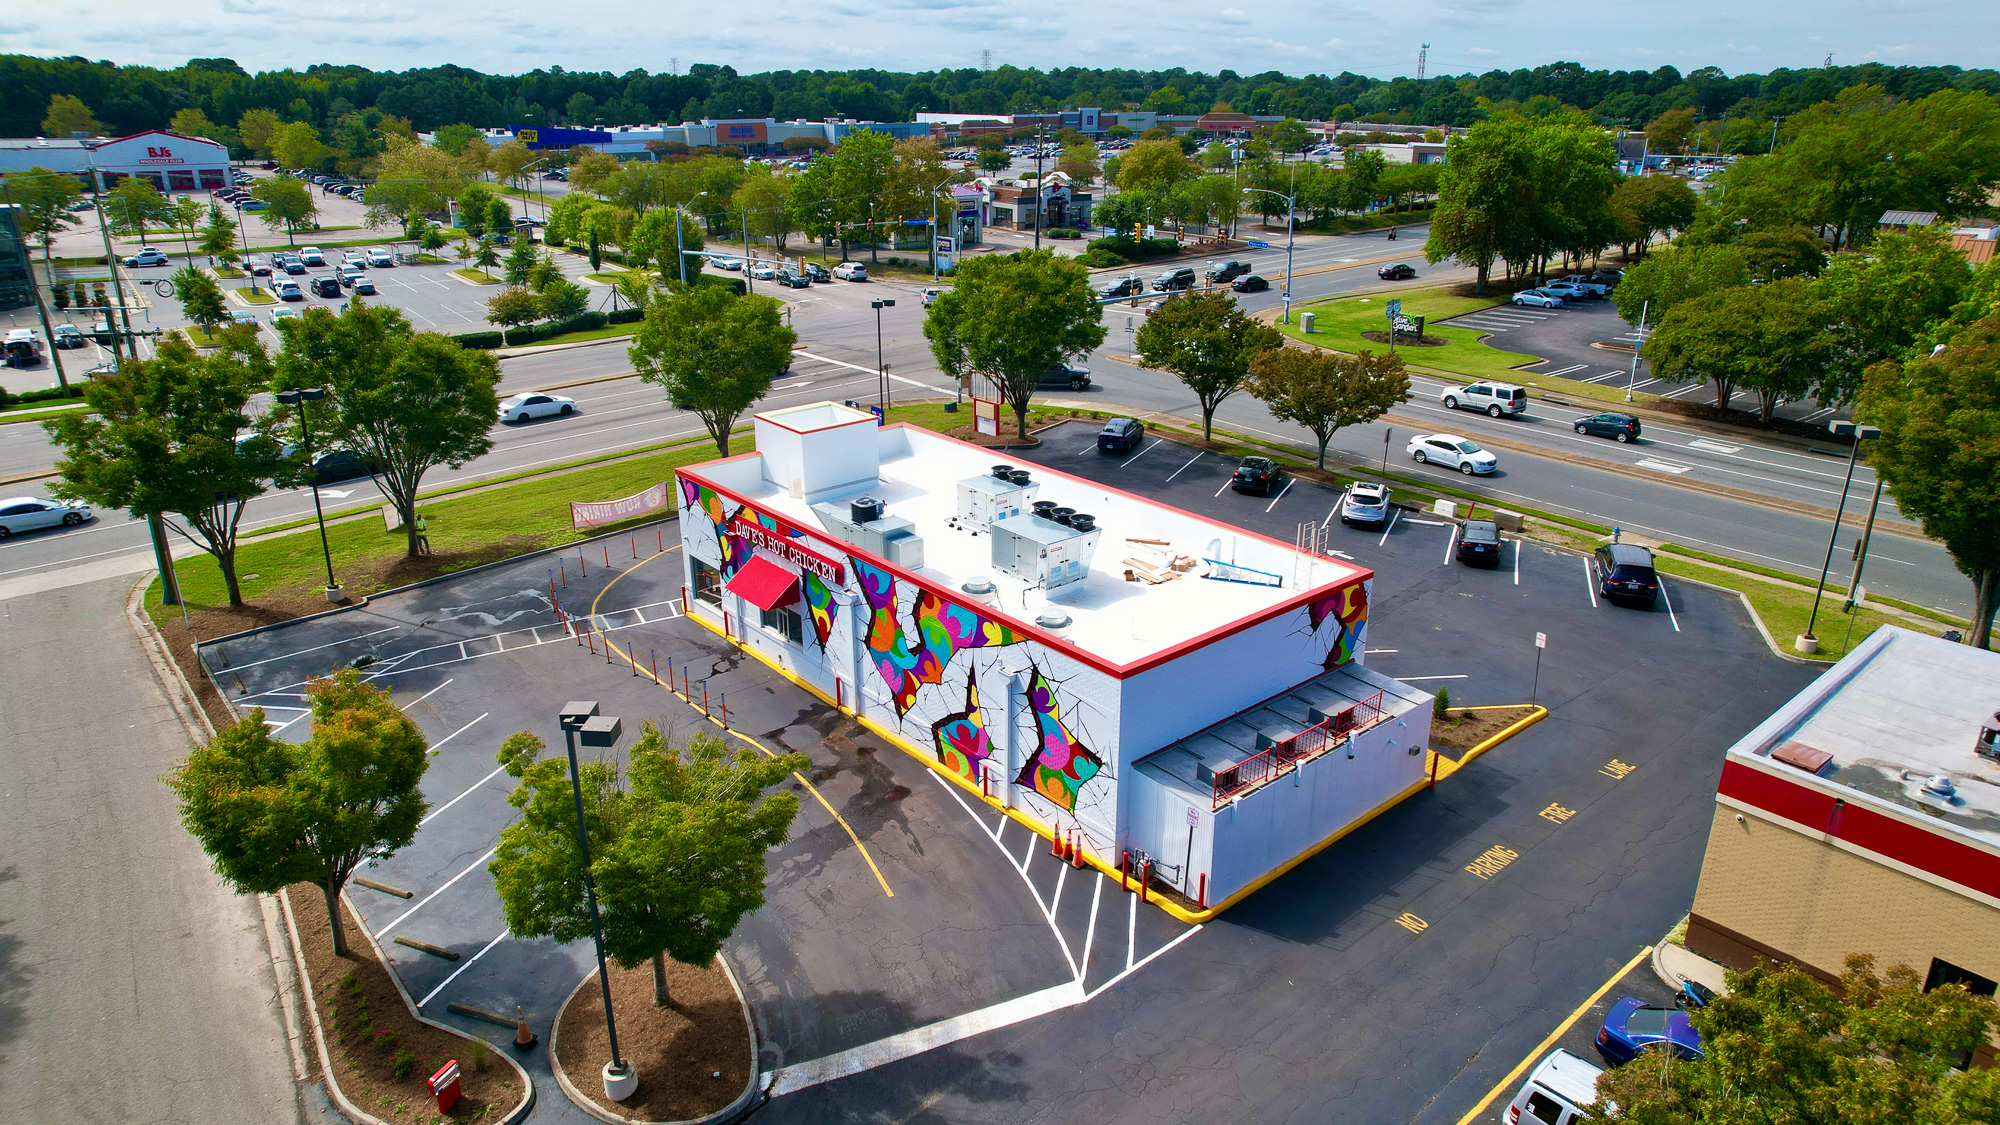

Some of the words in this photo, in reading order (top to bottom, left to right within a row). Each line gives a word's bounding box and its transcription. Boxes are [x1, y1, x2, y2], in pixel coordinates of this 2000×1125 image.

[730, 126, 754, 134] ROSS
[147, 147, 172, 158] BJ's
[735, 521, 765, 547] DAVE'S
[767, 536, 786, 558] HOT
[789, 547, 836, 583] CHICKEN
[1598, 758, 1636, 780] LANE
[1538, 802, 1577, 825] FIRE
[1464, 844, 1519, 880] PARKING
[1394, 912, 1429, 935] NO
